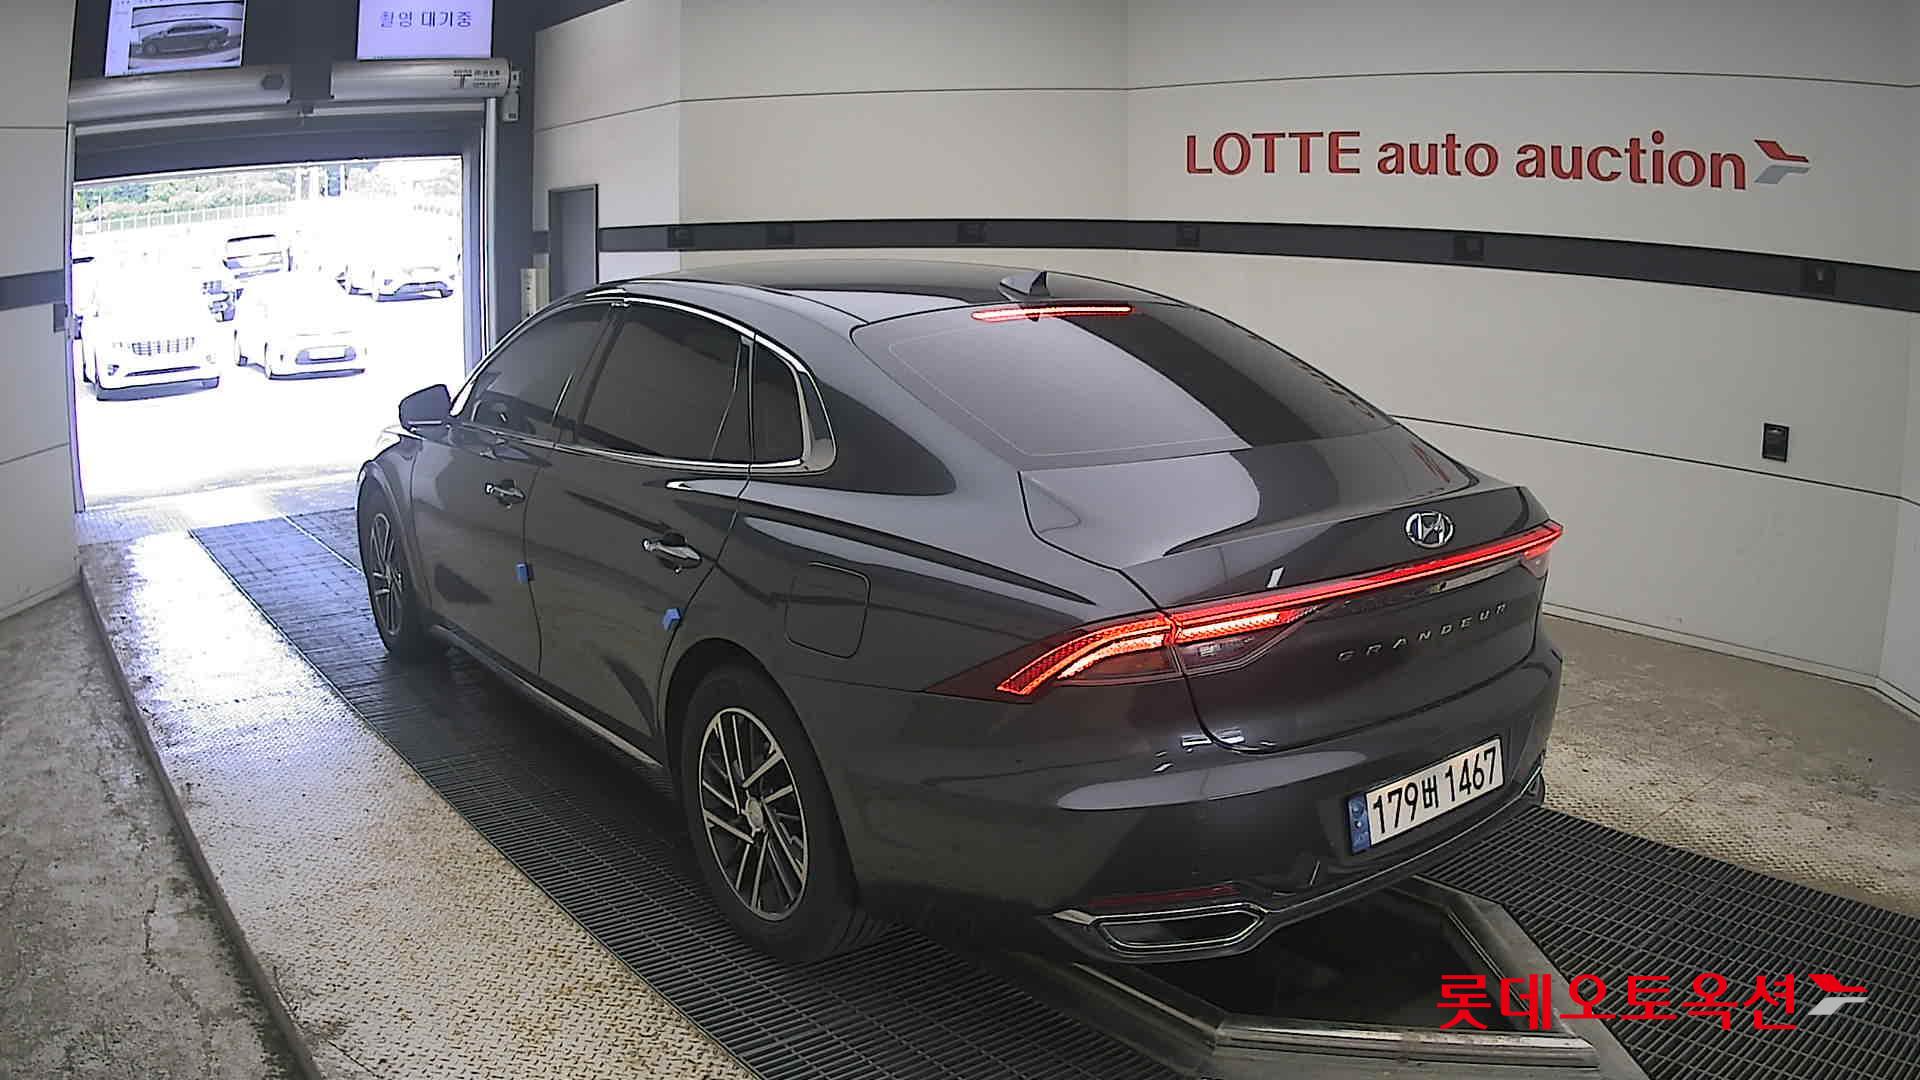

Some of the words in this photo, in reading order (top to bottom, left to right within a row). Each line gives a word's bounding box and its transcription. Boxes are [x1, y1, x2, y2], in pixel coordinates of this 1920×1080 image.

[420, 10, 473, 28] 대기중
[1185, 131, 1361, 175] LOTTE
[1377, 133, 1499, 177] auto
[1515, 130, 1746, 190] auction
[1336, 602, 1508, 663] GRANDEUR
[1371, 774, 1439, 834] 179버
[1444, 746, 1498, 802] 1467
